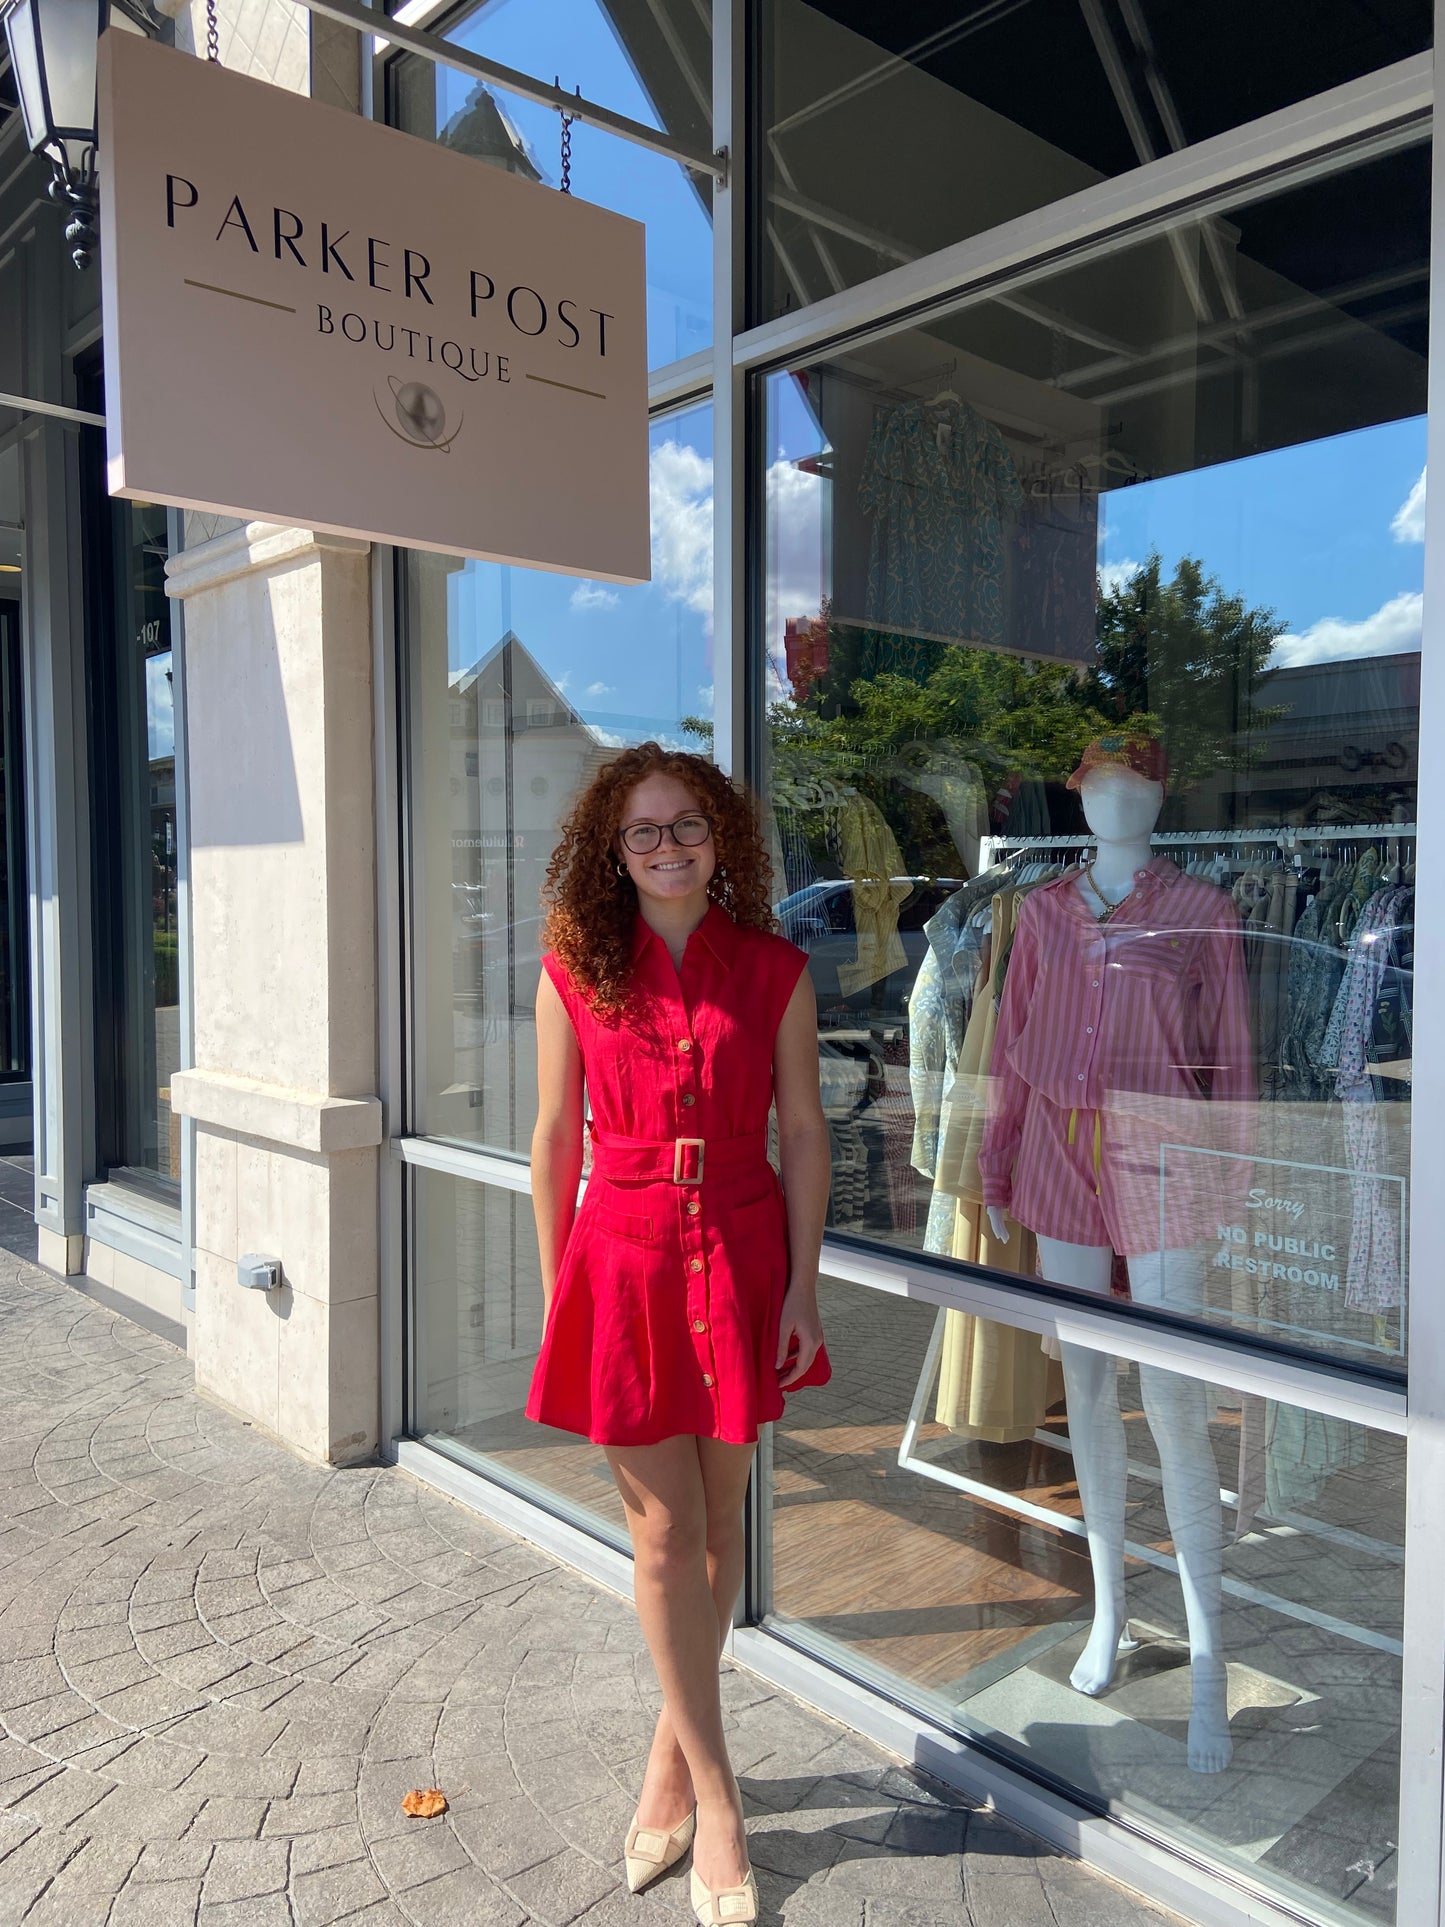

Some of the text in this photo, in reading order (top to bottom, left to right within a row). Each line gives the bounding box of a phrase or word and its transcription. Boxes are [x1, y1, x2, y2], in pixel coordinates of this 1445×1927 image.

[165, 173, 616, 357] PARKER POST
[317, 304, 512, 384] BOUTIQUE
[1245, 1188, 1305, 1220] Sorry
[1216, 1223, 1336, 1261] NO PUBLIC
[1214, 1251, 1339, 1291] RESTROOM
